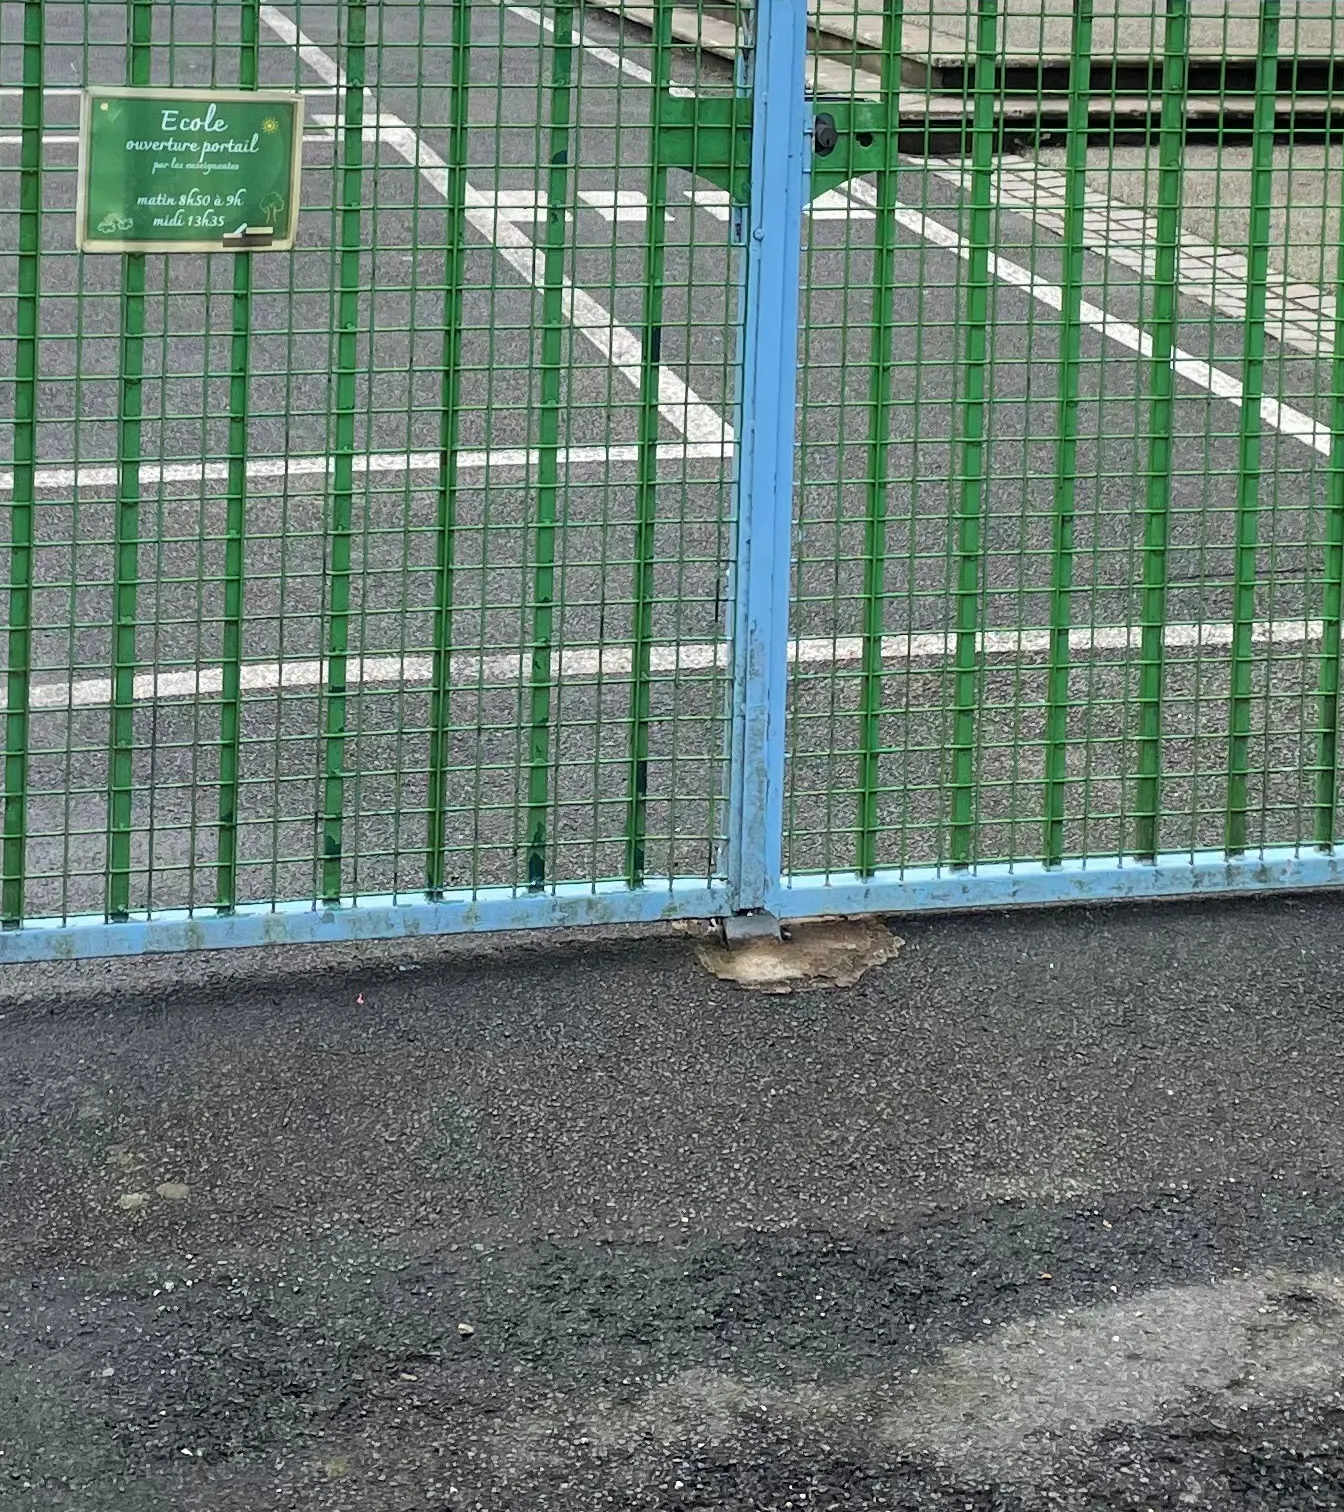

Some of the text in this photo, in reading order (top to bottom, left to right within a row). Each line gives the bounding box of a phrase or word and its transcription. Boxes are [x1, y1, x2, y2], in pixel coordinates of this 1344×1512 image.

[161, 103, 228, 132] Ecole
[126, 133, 260, 162] ouverture portail
[151, 157, 239, 175] par les enseignantes
[137, 187, 247, 207] matin 8h50 à 9h
[153, 209, 226, 227] midi 13h35
